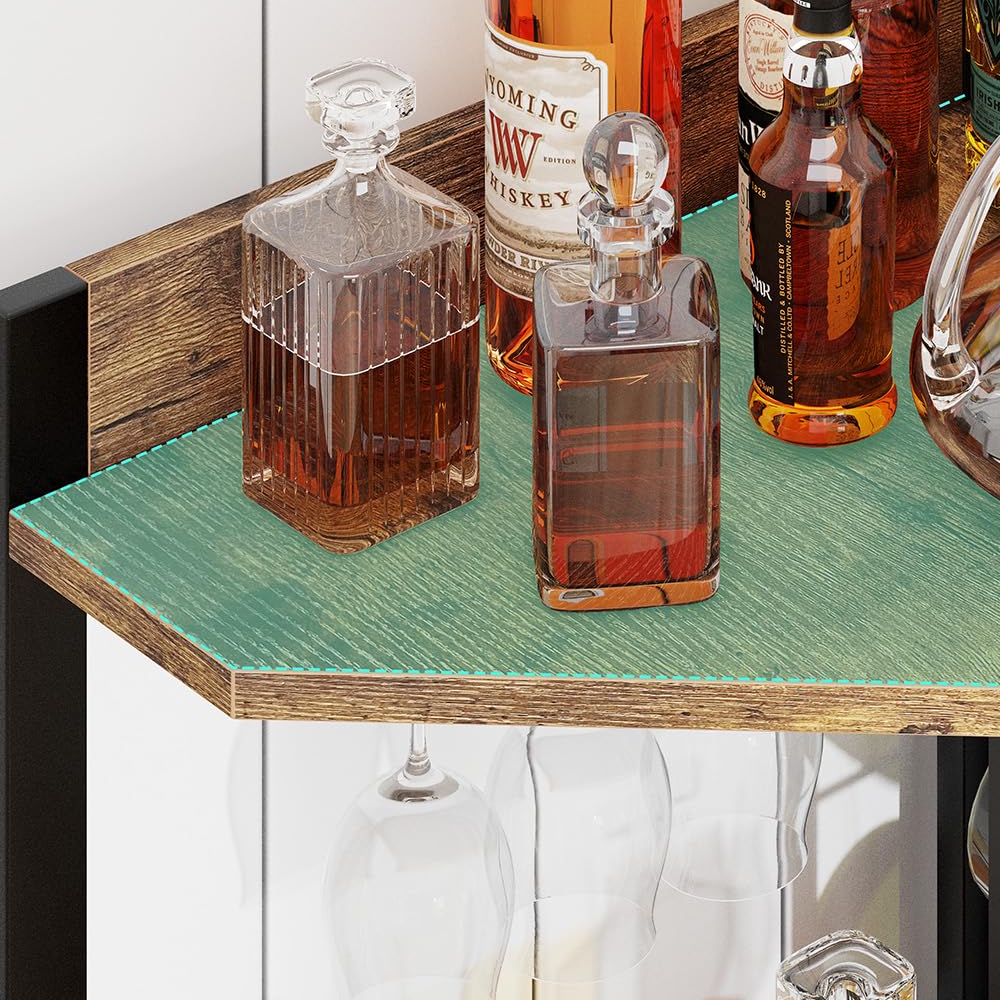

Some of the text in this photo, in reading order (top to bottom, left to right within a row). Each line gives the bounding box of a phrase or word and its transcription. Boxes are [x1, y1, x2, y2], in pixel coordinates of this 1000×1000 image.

[975, 86, 1000, 111] IRISH
[543, 156, 577, 165] EDITION
[777, 242, 785, 255] BY
[778, 258, 787, 297] BOTTLED
[785, 245, 793, 300] CAMPBELTOWN
[779, 309, 787, 354] DISTILLED
